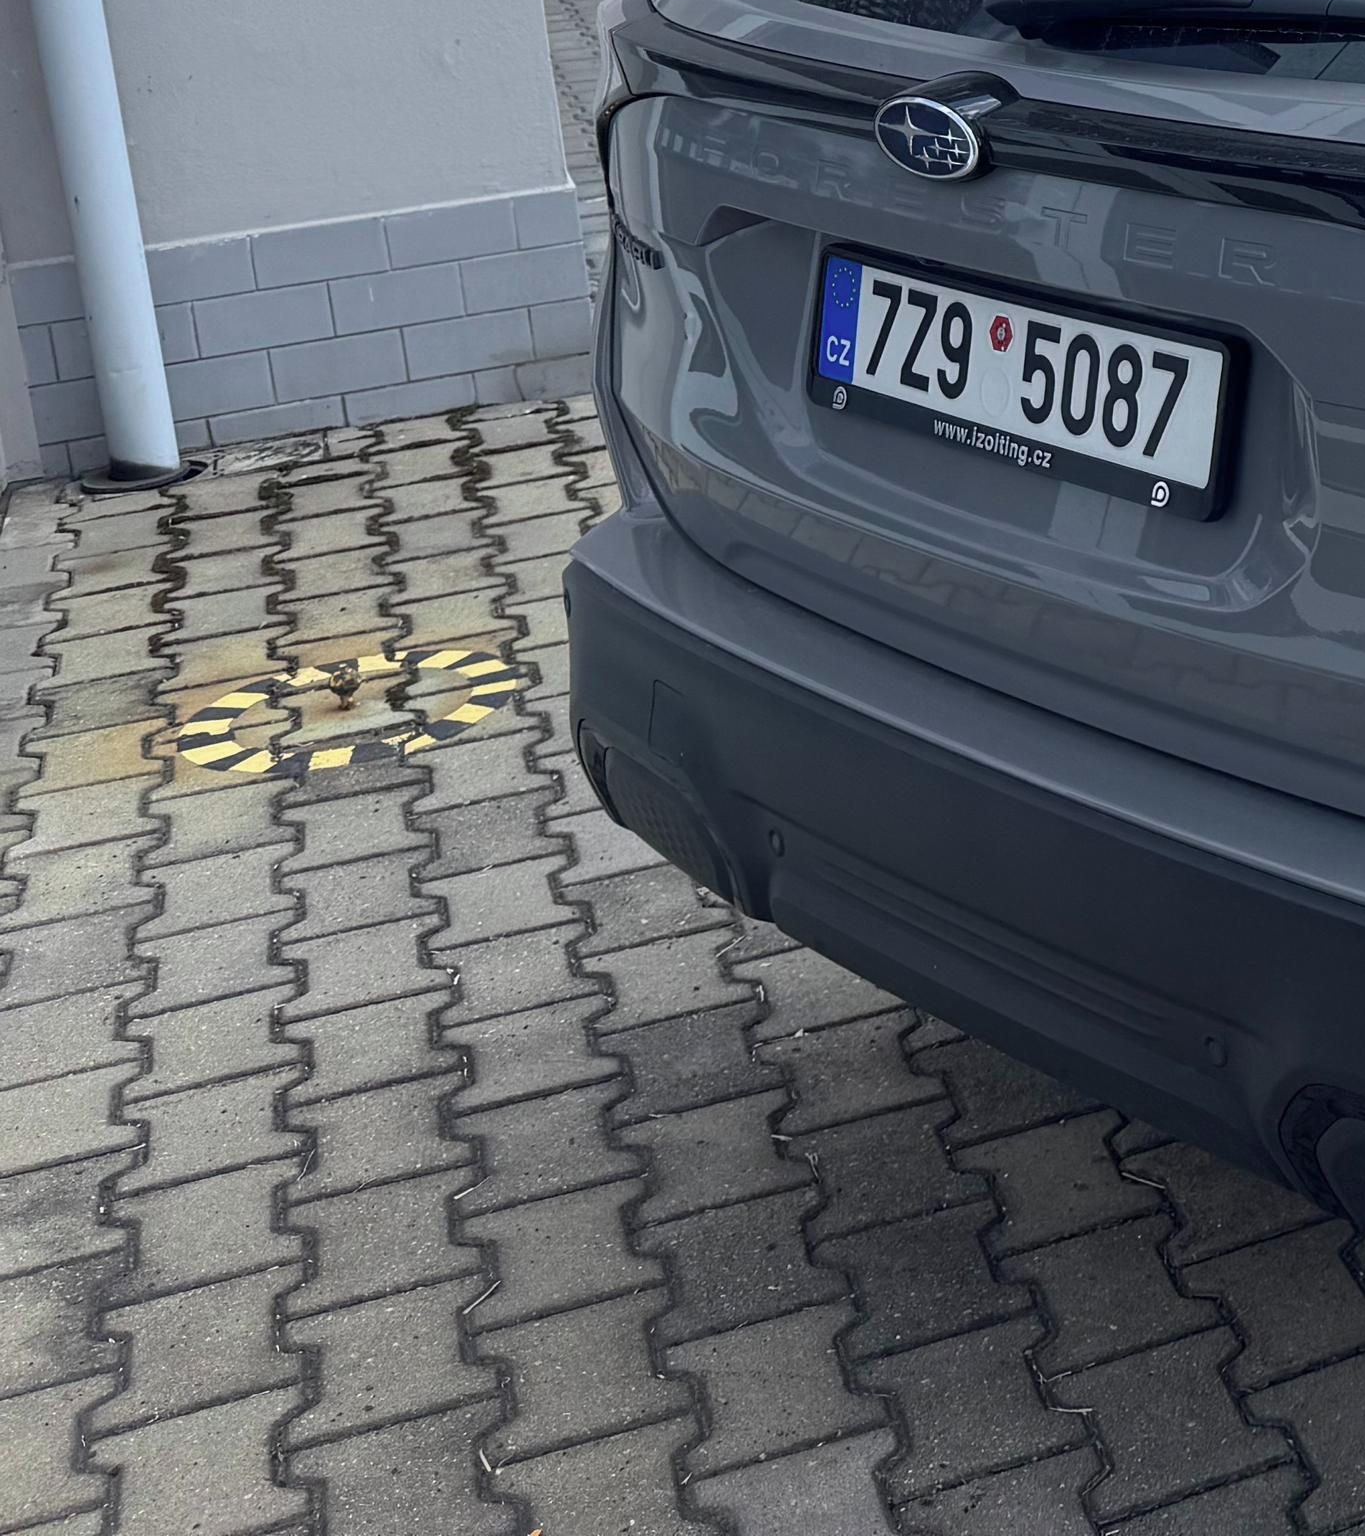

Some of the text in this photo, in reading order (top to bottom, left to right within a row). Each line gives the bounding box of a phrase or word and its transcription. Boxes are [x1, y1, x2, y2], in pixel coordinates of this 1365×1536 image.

[826, 279, 1190, 458] CZ 7Z9 5087
